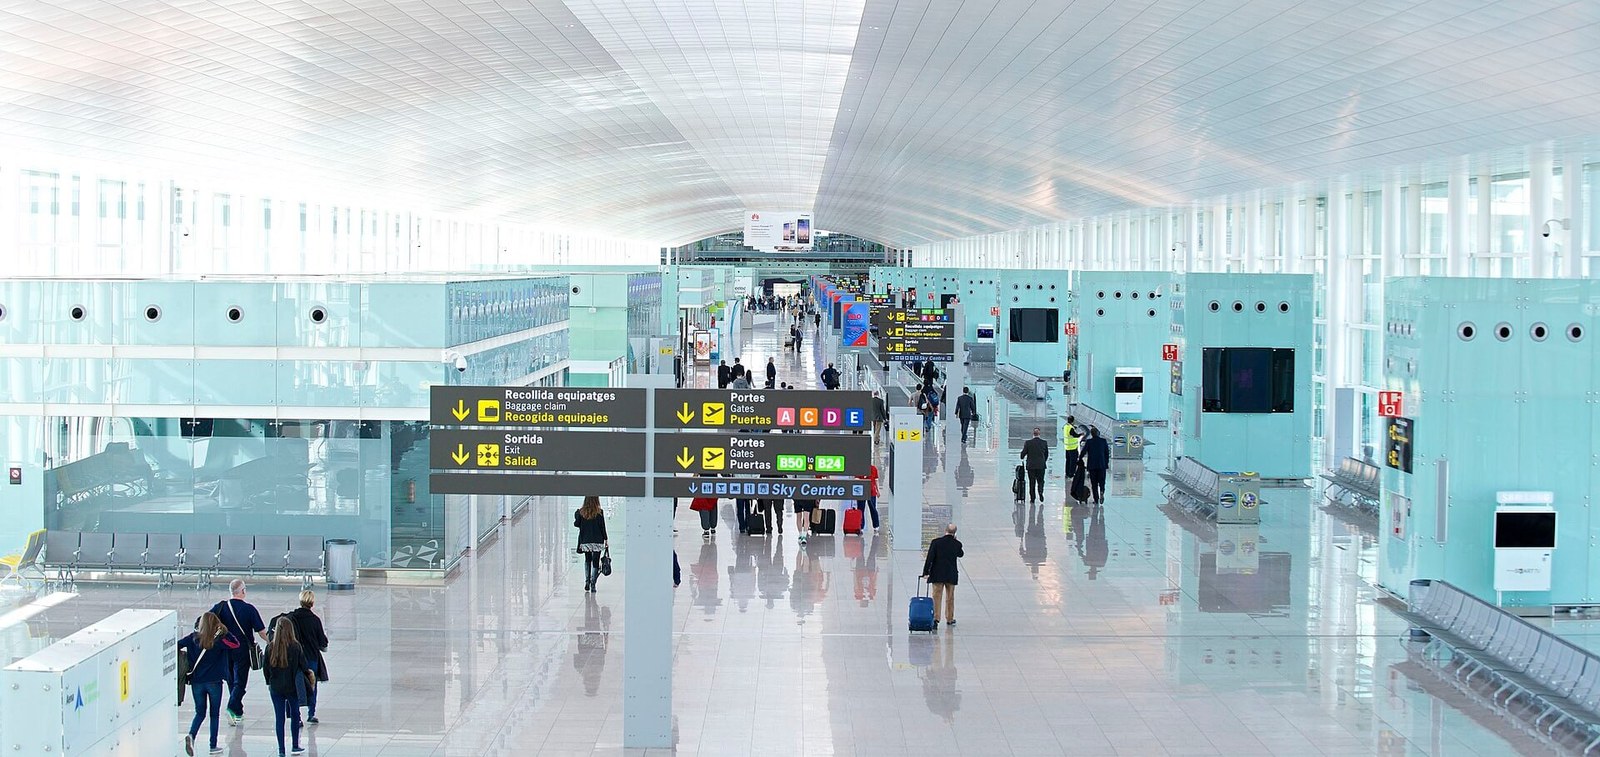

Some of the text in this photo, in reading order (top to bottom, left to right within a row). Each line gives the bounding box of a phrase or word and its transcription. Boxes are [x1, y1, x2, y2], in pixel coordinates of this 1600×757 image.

[505, 389, 616, 402] Recollida equipatges
[730, 392, 766, 402] Portes
[505, 401, 567, 412] Baggage claim
[730, 404, 755, 413] Gates
[505, 412, 609, 425] Recogida equipajes
[730, 410, 859, 425] Puertas A C D E
[504, 433, 544, 444] Sortida
[730, 437, 766, 448] Portes
[504, 445, 521, 455] Exit
[730, 449, 755, 458] Gates
[504, 456, 538, 467] Salida
[730, 460, 771, 470] Puertas
[780, 458, 804, 469] B50
[818, 458, 842, 469] B24
[772, 484, 846, 498] Sky Centre
